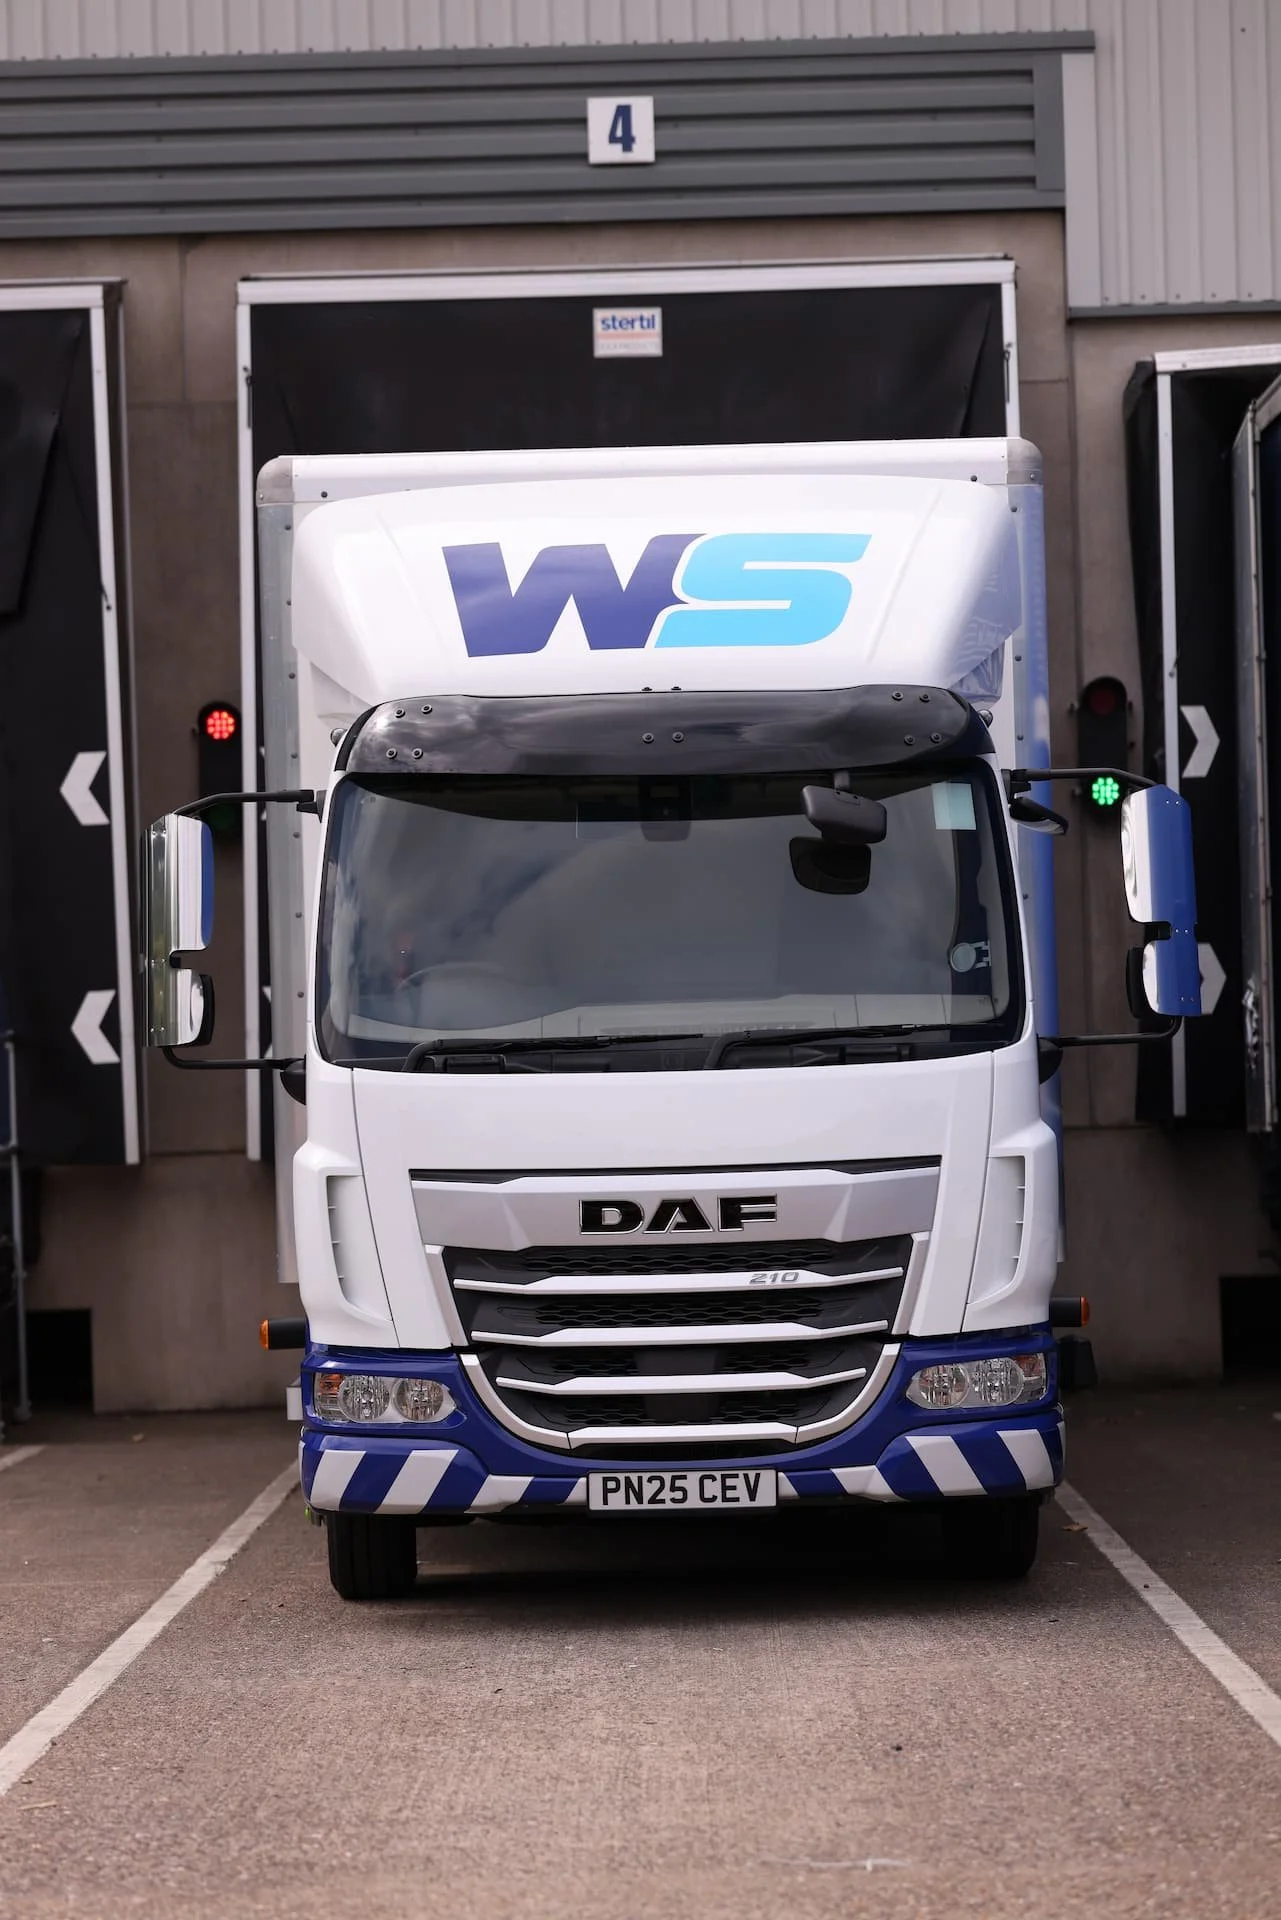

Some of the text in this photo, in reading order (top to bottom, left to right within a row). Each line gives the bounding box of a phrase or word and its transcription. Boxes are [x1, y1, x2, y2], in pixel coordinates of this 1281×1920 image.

[608, 104, 636, 153] 4
[601, 314, 656, 331] stertil
[441, 533, 873, 657] WS
[579, 1194, 778, 1235] DAF
[749, 1271, 800, 1285] 210
[602, 1472, 761, 1506] PN25 CEV
